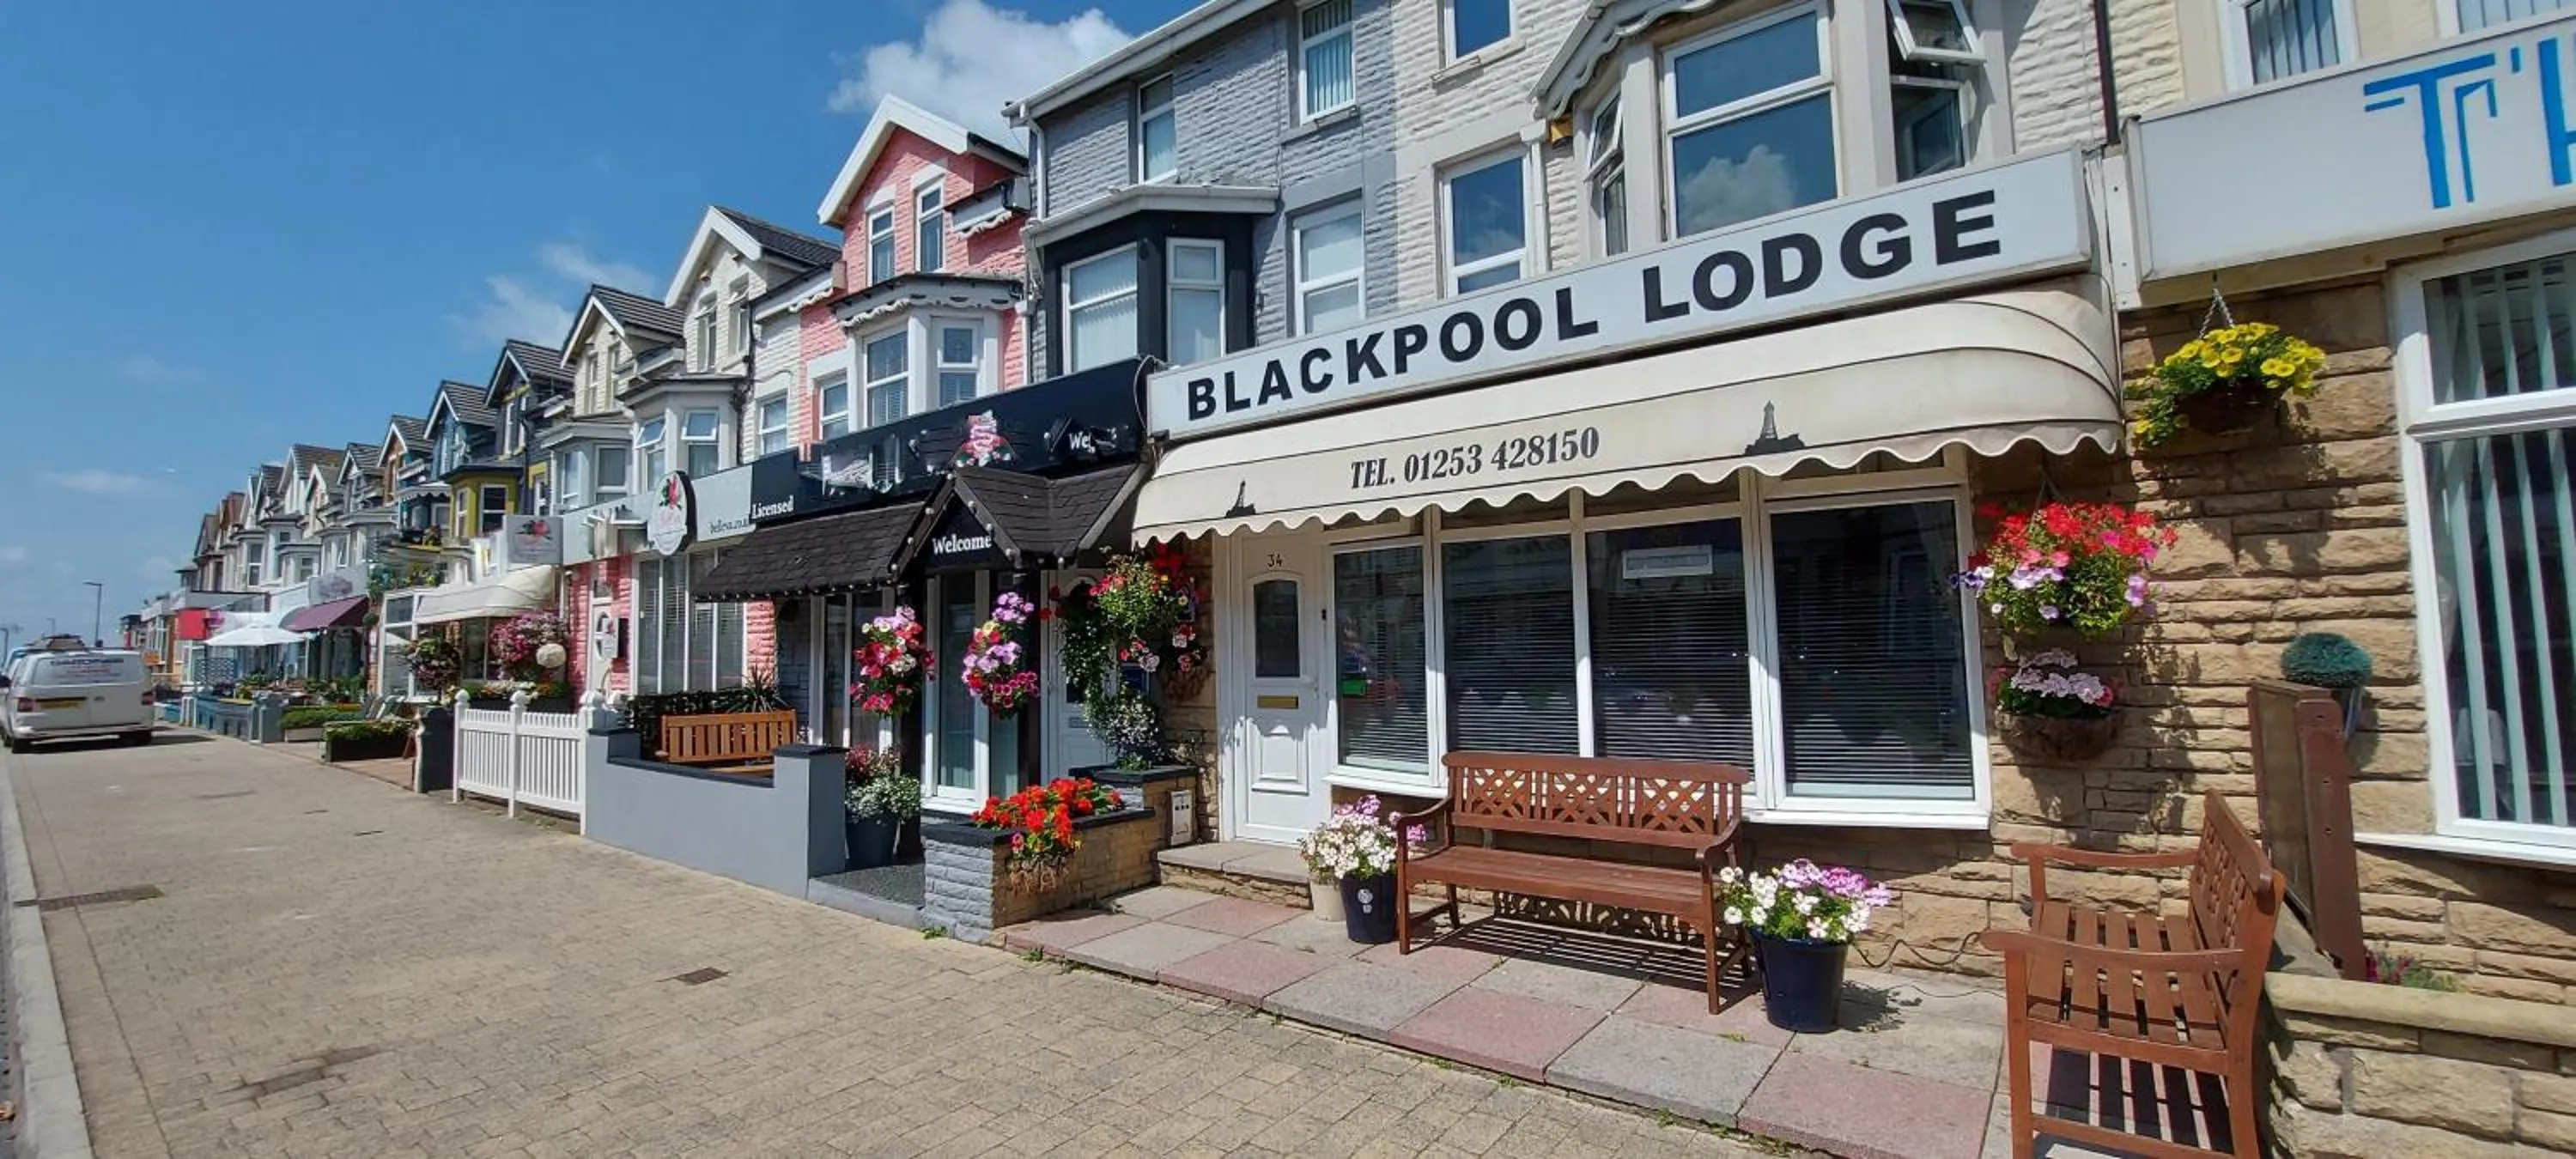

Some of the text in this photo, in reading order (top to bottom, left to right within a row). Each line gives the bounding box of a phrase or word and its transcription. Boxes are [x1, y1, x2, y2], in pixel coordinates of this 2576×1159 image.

[1188, 189, 2001, 422] BLACKPOOL LODGE
[1350, 426, 1600, 489] TEL. 01253 428150
[751, 495, 794, 519] Licensed
[932, 533, 992, 555] Welcome
[1267, 553, 1284, 567] 34
